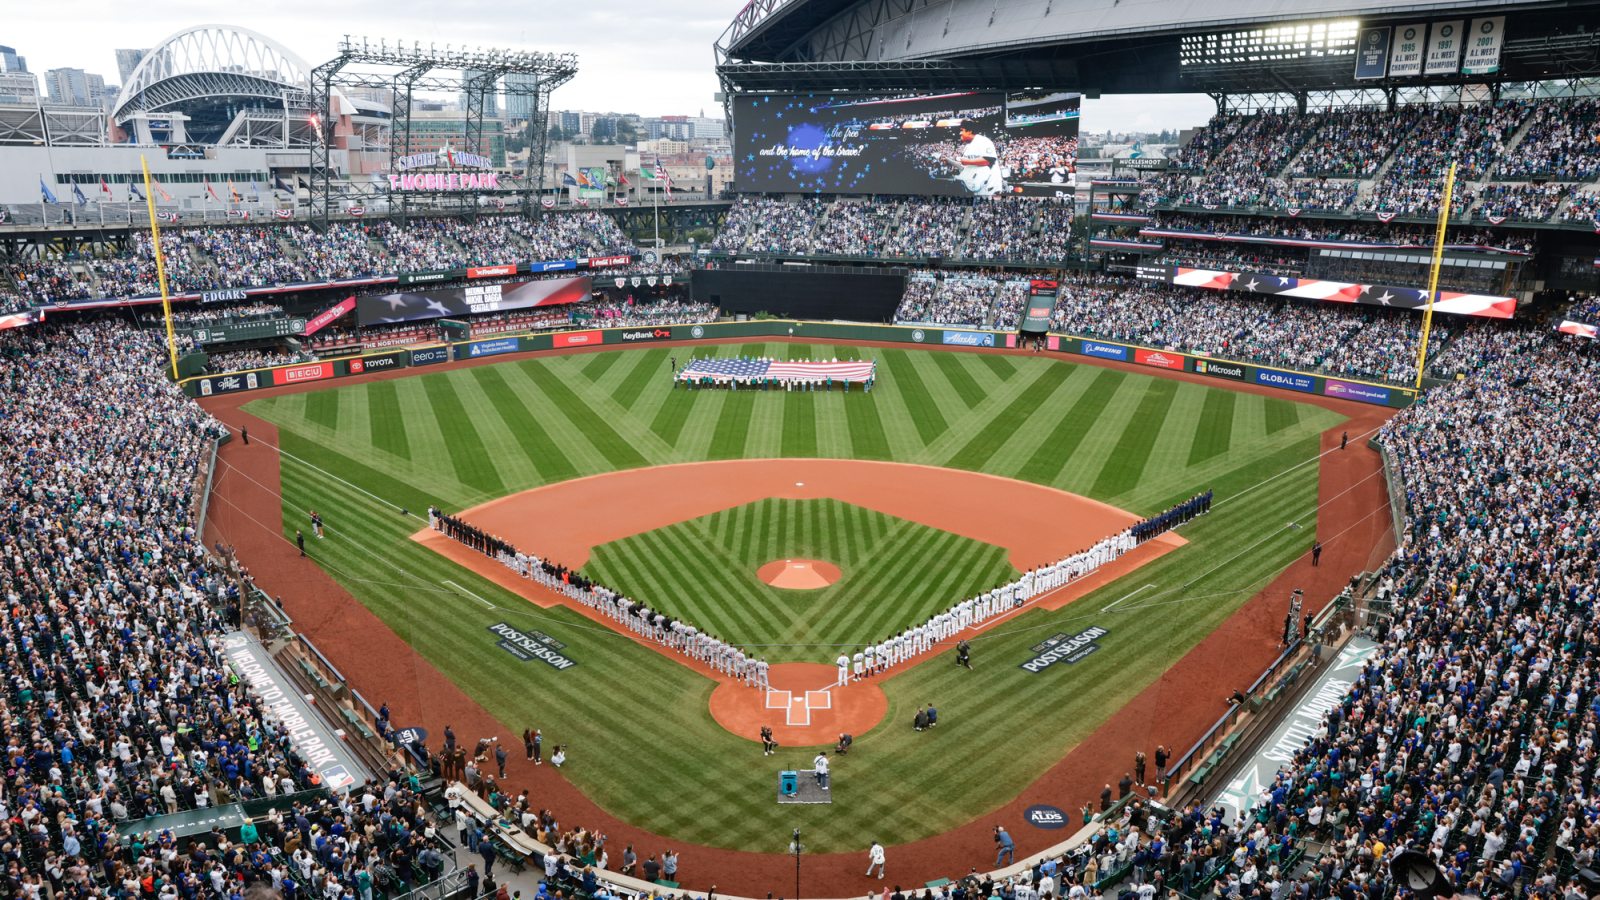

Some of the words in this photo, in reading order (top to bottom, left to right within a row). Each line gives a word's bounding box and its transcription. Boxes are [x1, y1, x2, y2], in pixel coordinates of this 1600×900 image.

[1401, 43, 1416, 52] 1995
[1438, 40, 1452, 49] 1997
[1477, 37, 1493, 46] 2001
[1392, 63, 1419, 71] CHAMPIONS
[1427, 61, 1456, 69] CHAMPIONS
[1466, 58, 1497, 67] CHAMPIONS
[843, 128, 859, 142] free
[760, 146, 776, 155] and
[776, 146, 788, 155] the
[789, 146, 810, 156] home
[812, 145, 822, 160] of
[823, 145, 835, 155] the
[836, 145, 864, 156] brave?
[400, 152, 436, 170] SEATTLE
[455, 151, 492, 168] MARINERS
[388, 174, 459, 190] T-MOBILE
[460, 173, 499, 188] PARK
[203, 290, 247, 302] EDGARS
[320, 314, 333, 324] Mobile
[378, 337, 417, 347] NORTHWEST
[622, 332, 653, 340] KeyBank
[946, 333, 978, 344] Alaska
[1094, 346, 1122, 354] BOEING
[365, 358, 394, 368] TOYOTA
[414, 352, 434, 362] eero
[1208, 364, 1242, 376] Microsoft
[1260, 373, 1294, 385] GLOBAL
[490, 623, 574, 670] POSTSEASON
[1022, 626, 1107, 672] POSTSEASON
[231, 648, 272, 688] WELCOME
[259, 685, 283, 700] TO
[268, 697, 316, 741] T-MOBILE
[1262, 720, 1318, 764] SEATTLE
[1296, 677, 1354, 722] MARINERS
[299, 736, 338, 768] PARK
